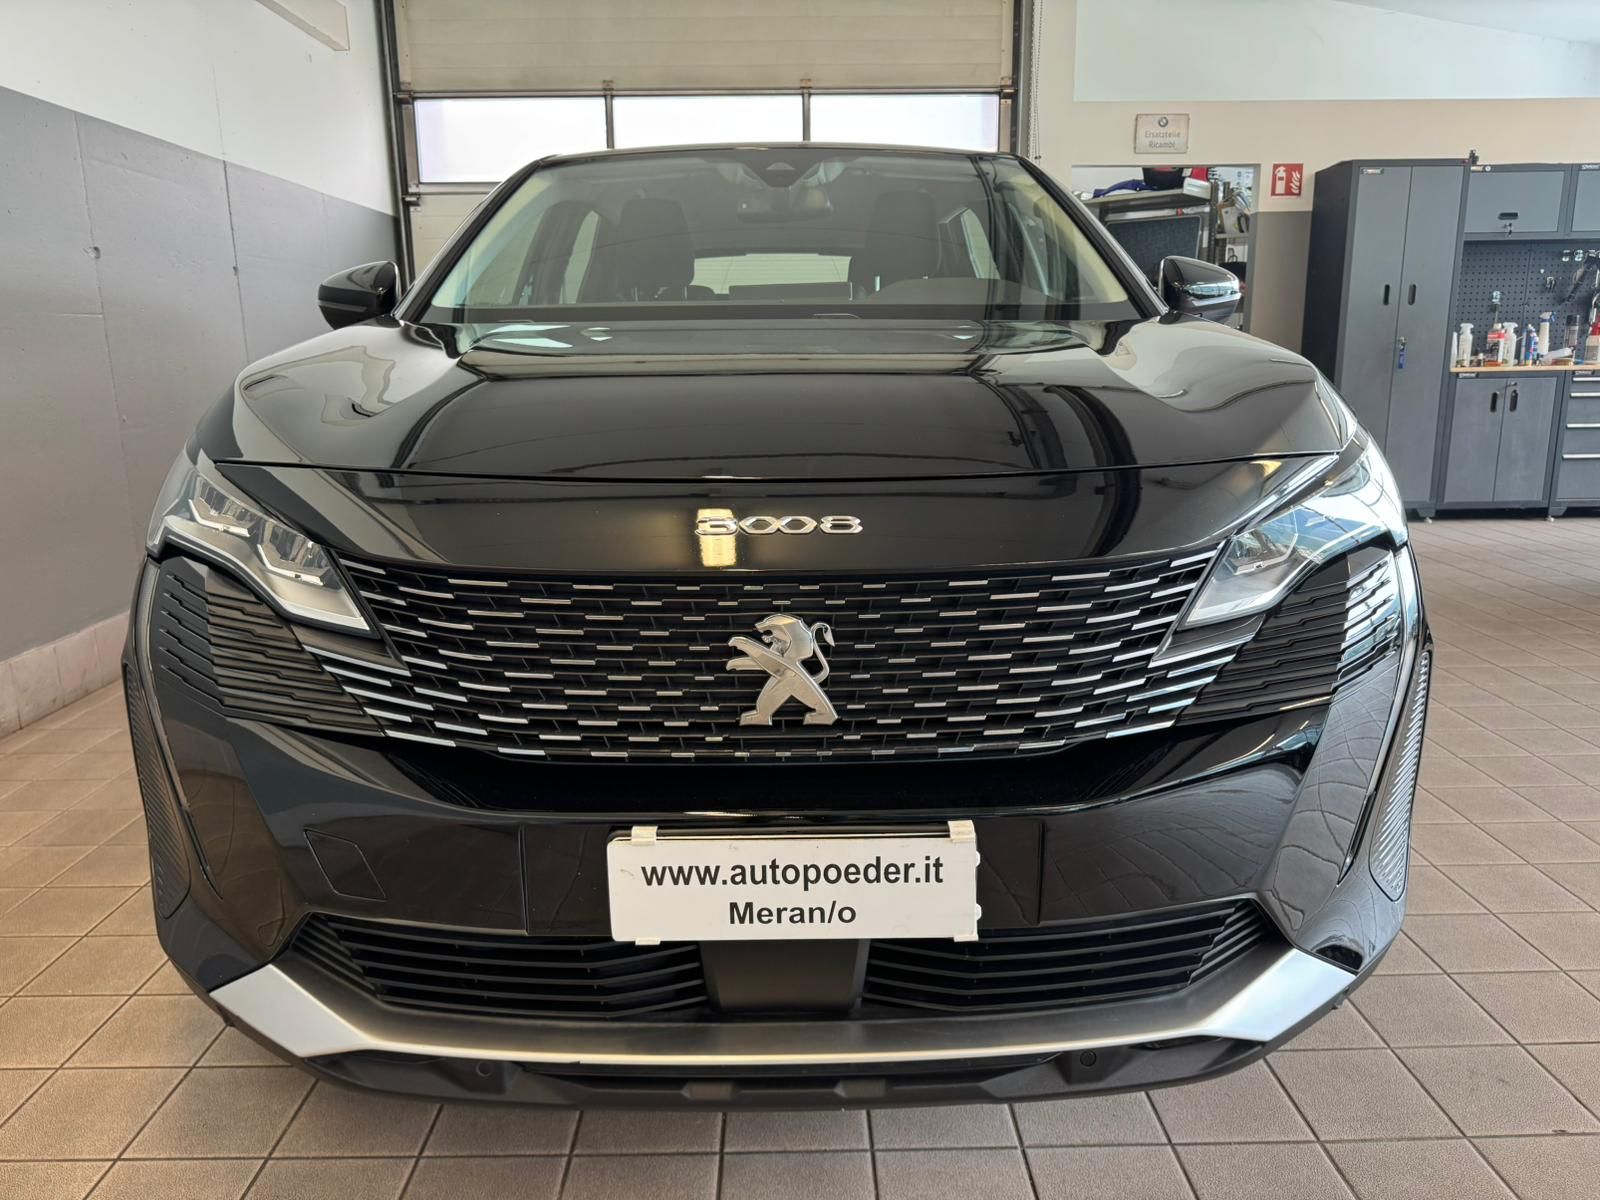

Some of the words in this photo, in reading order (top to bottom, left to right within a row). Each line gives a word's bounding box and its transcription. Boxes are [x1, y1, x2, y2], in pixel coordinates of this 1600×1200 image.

[695, 515, 863, 536] 3008
[641, 856, 944, 891] www.autopoeder.it
[729, 901, 857, 925] Meran/o
